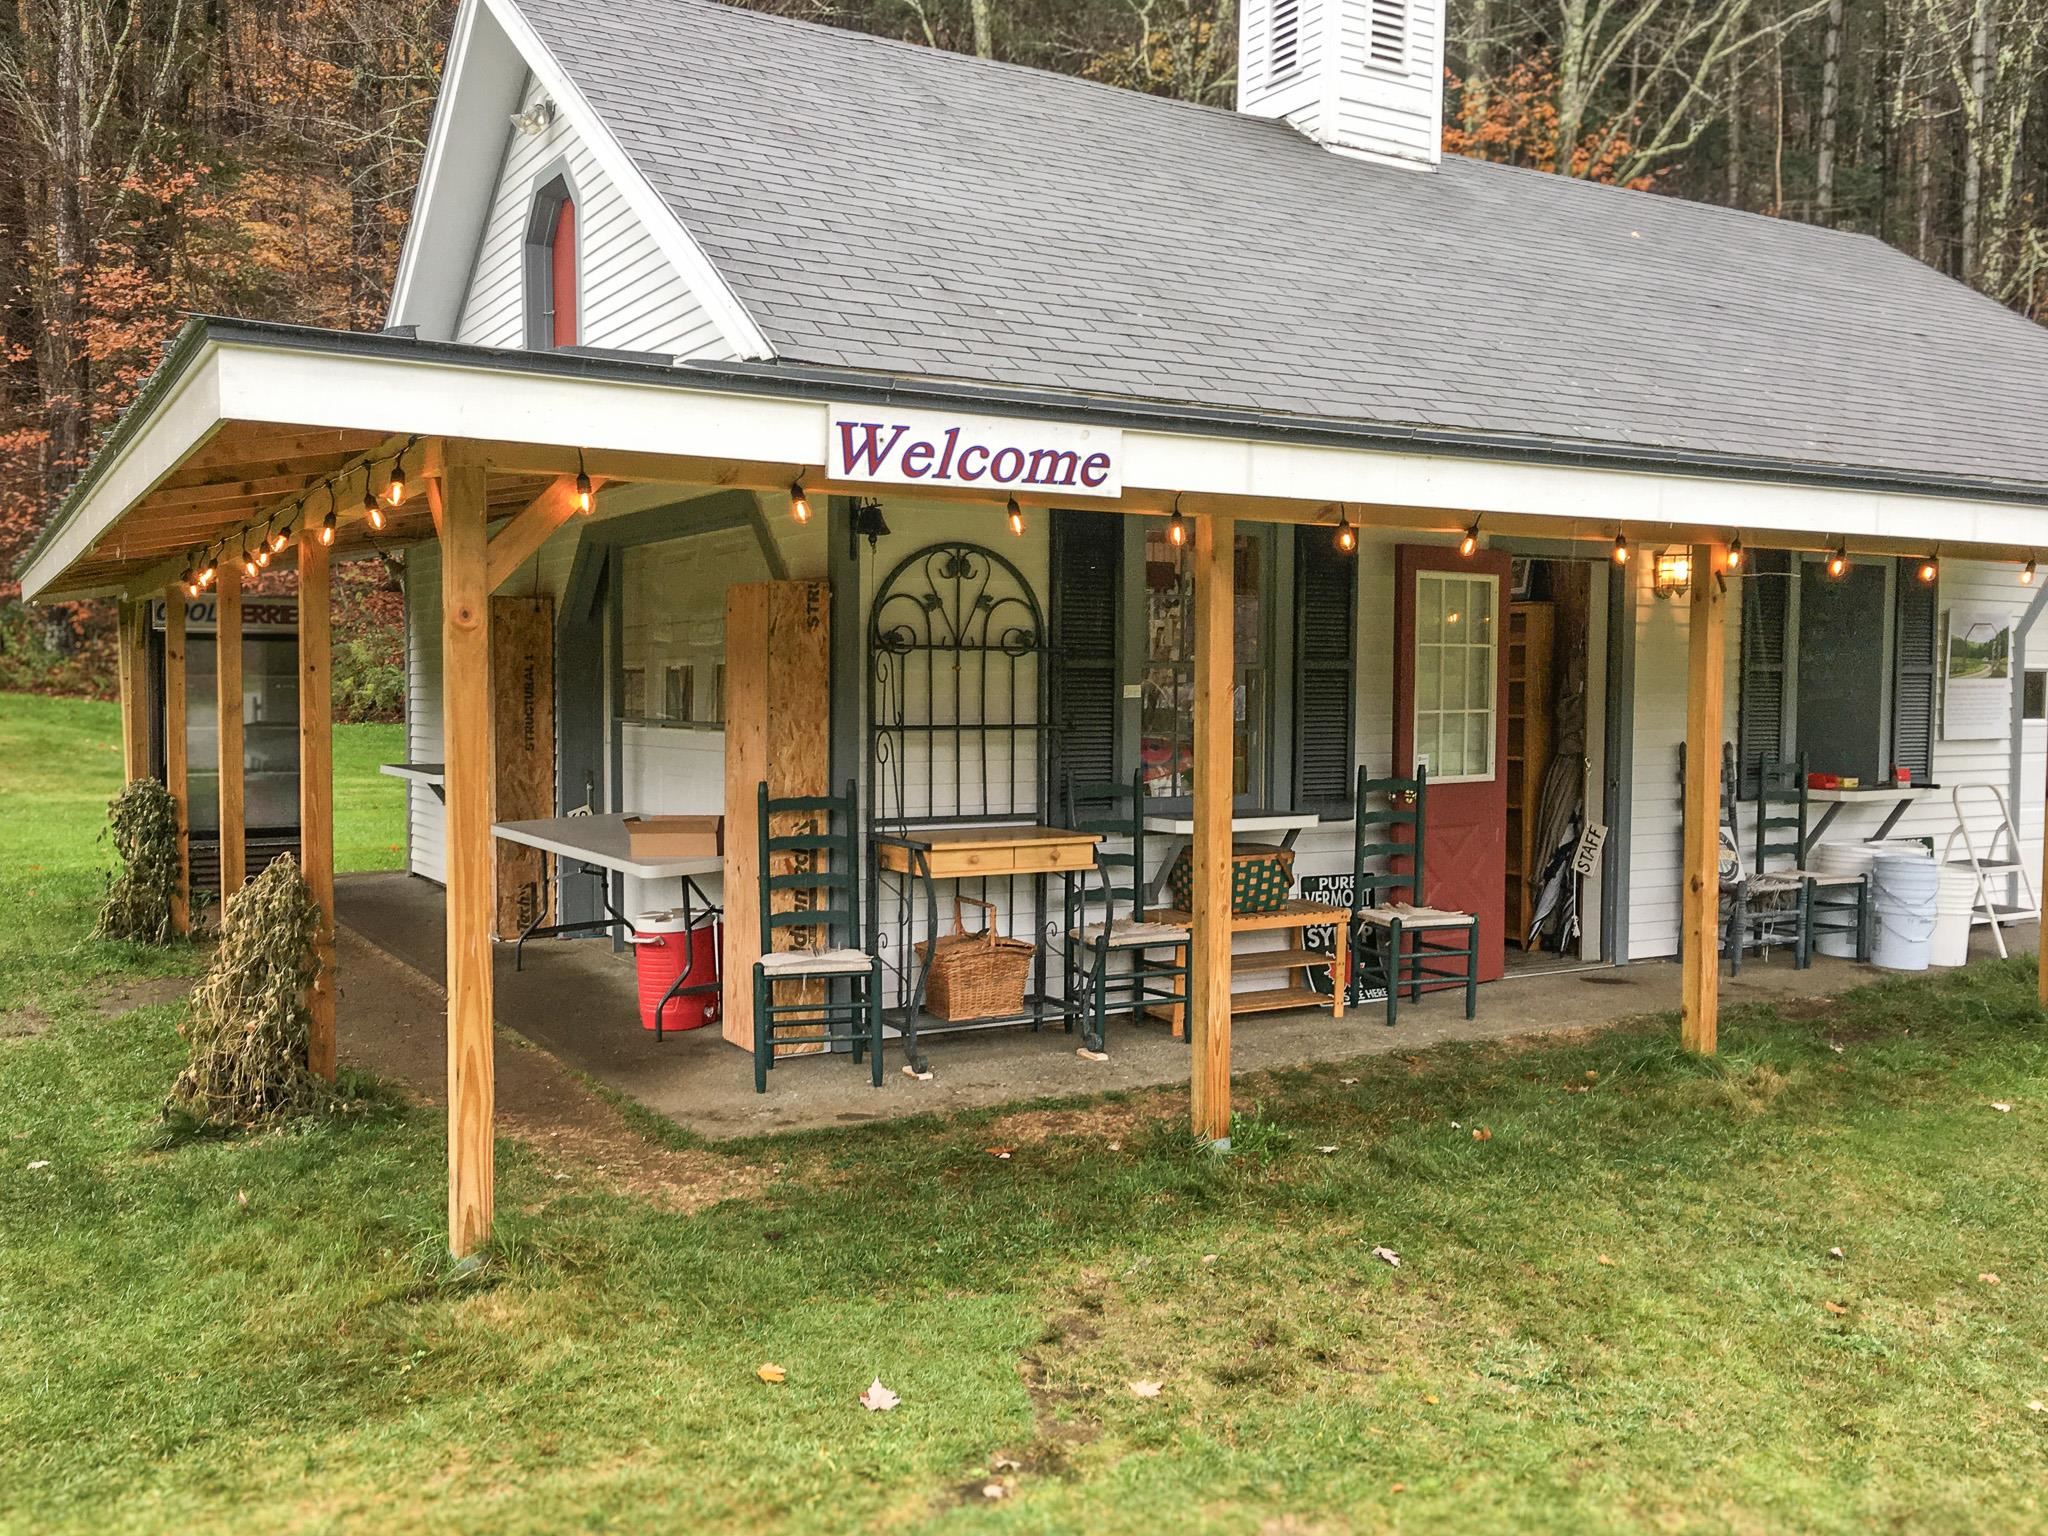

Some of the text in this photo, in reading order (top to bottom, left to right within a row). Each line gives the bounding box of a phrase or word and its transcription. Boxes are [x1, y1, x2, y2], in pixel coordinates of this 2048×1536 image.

[836, 421, 1111, 488] Welcome
[156, 602, 217, 622] COL
[1577, 824, 1602, 873] STAFF
[1319, 875, 1355, 890] PURE
[1304, 888, 1372, 907] VERMOT
[1364, 987, 1389, 999] HERE
